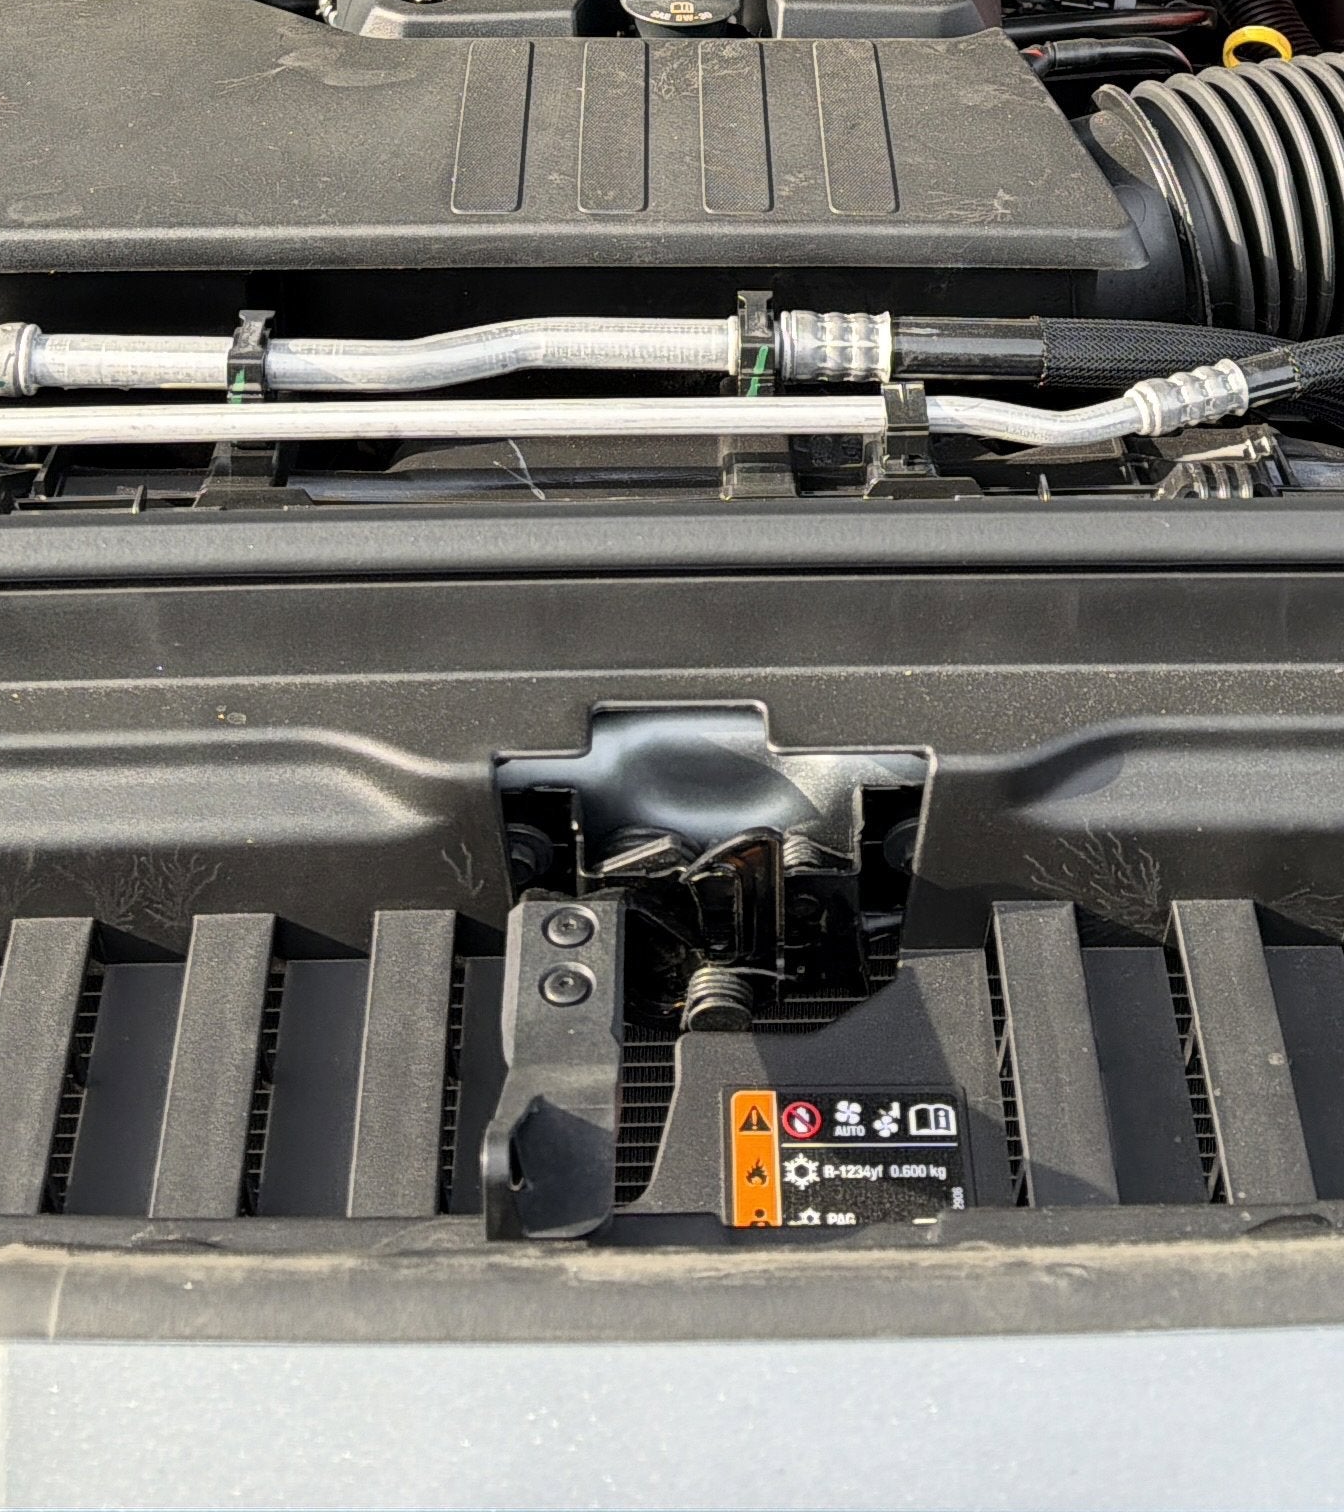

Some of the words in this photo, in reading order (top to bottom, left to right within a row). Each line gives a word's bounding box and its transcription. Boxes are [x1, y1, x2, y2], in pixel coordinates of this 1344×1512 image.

[650, 10, 671, 21] SAE
[834, 1124, 865, 1137] AUTO
[823, 1164, 883, 1181] R-1234yf
[890, 1164, 927, 1178] 0.600
[929, 1164, 947, 1180] kg
[826, 1212, 857, 1226] PAG
